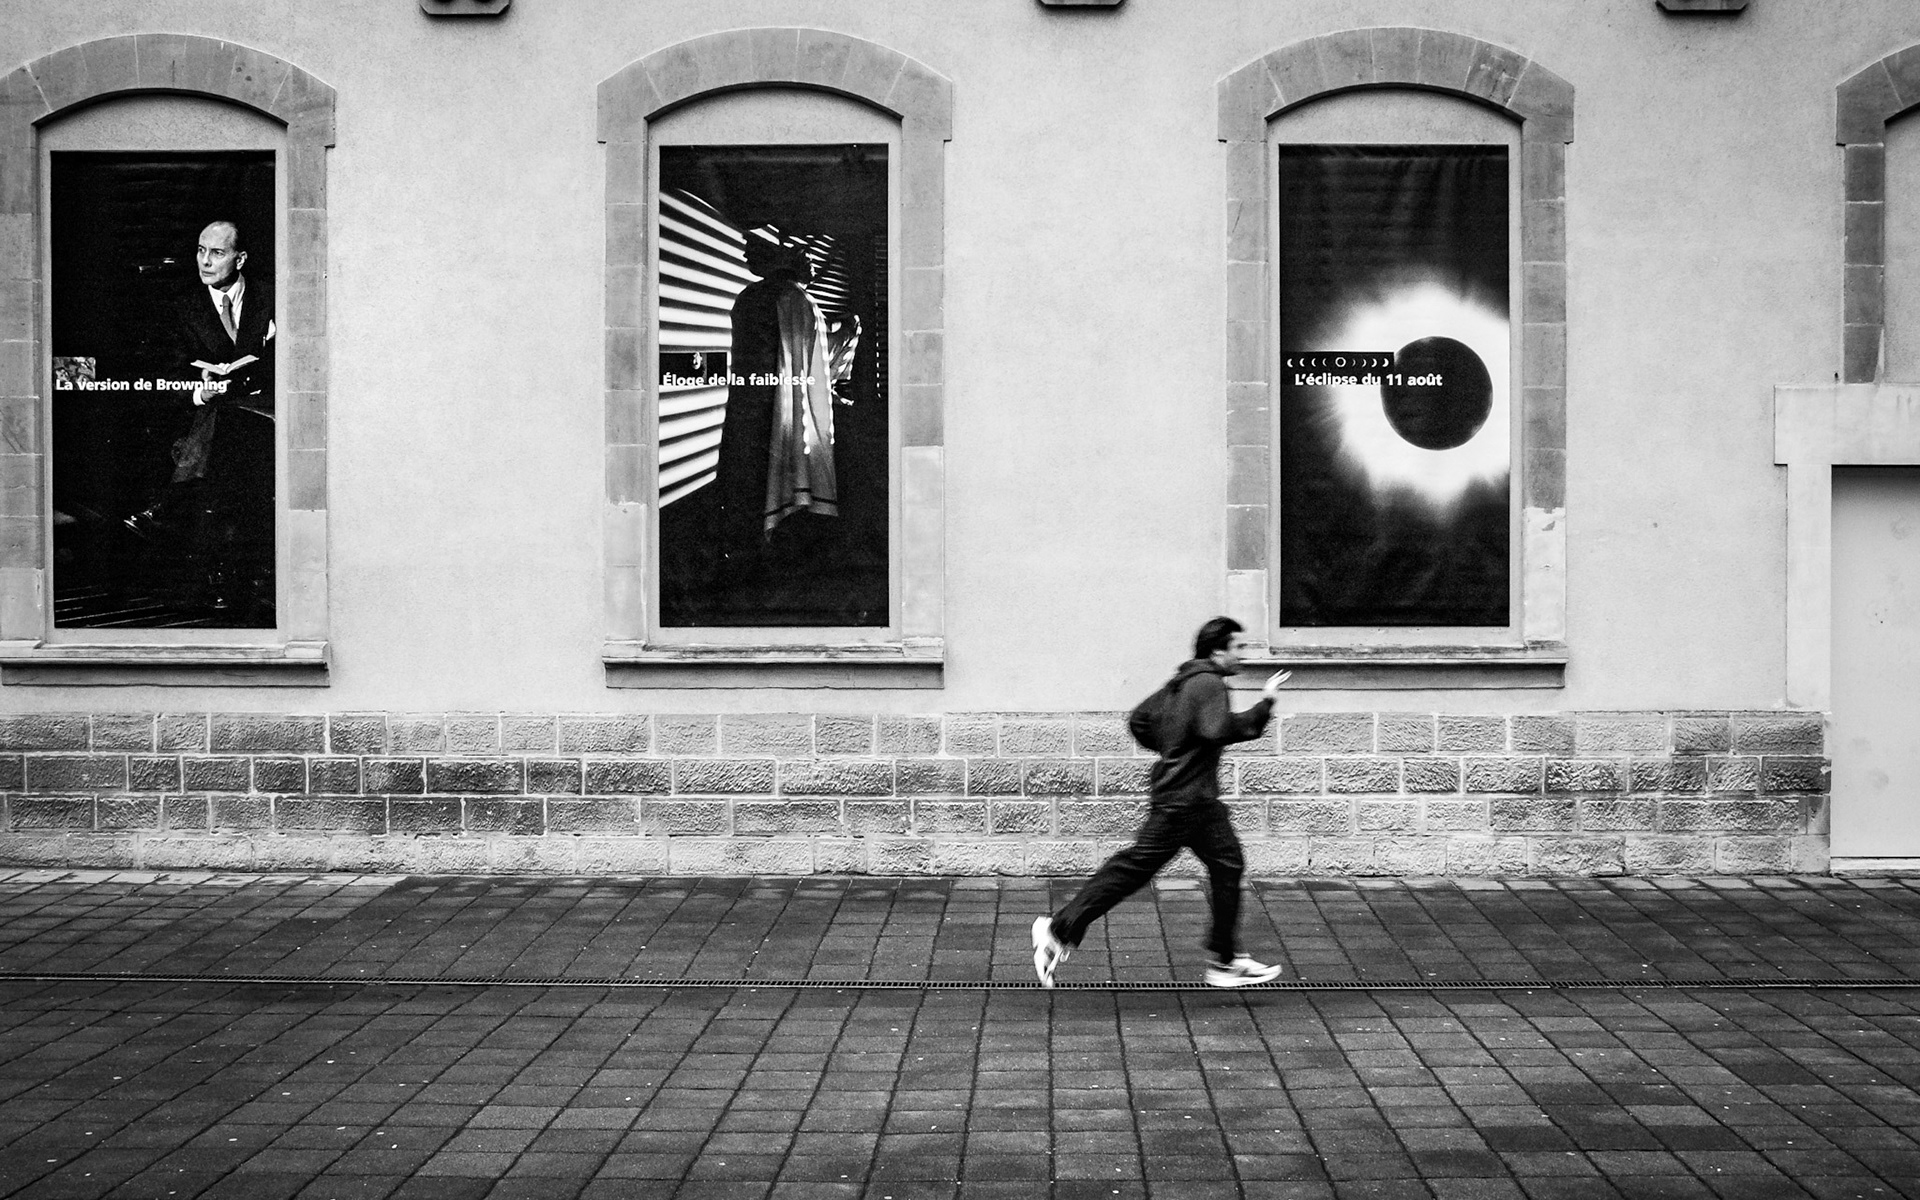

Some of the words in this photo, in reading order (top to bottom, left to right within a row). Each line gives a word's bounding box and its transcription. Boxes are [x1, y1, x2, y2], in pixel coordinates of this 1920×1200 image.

[56, 378, 73, 390] La
[77, 378, 130, 390] version
[134, 378, 152, 390] de
[156, 378, 228, 393] Browning
[662, 372, 705, 388] Éloge
[708, 373, 727, 386] de
[731, 373, 745, 386] la
[749, 373, 816, 386] faiblesse
[1295, 373, 1358, 388] L'éclipse
[1362, 373, 1381, 386] du
[1386, 374, 1402, 386] 11
[1407, 373, 1443, 386] août
